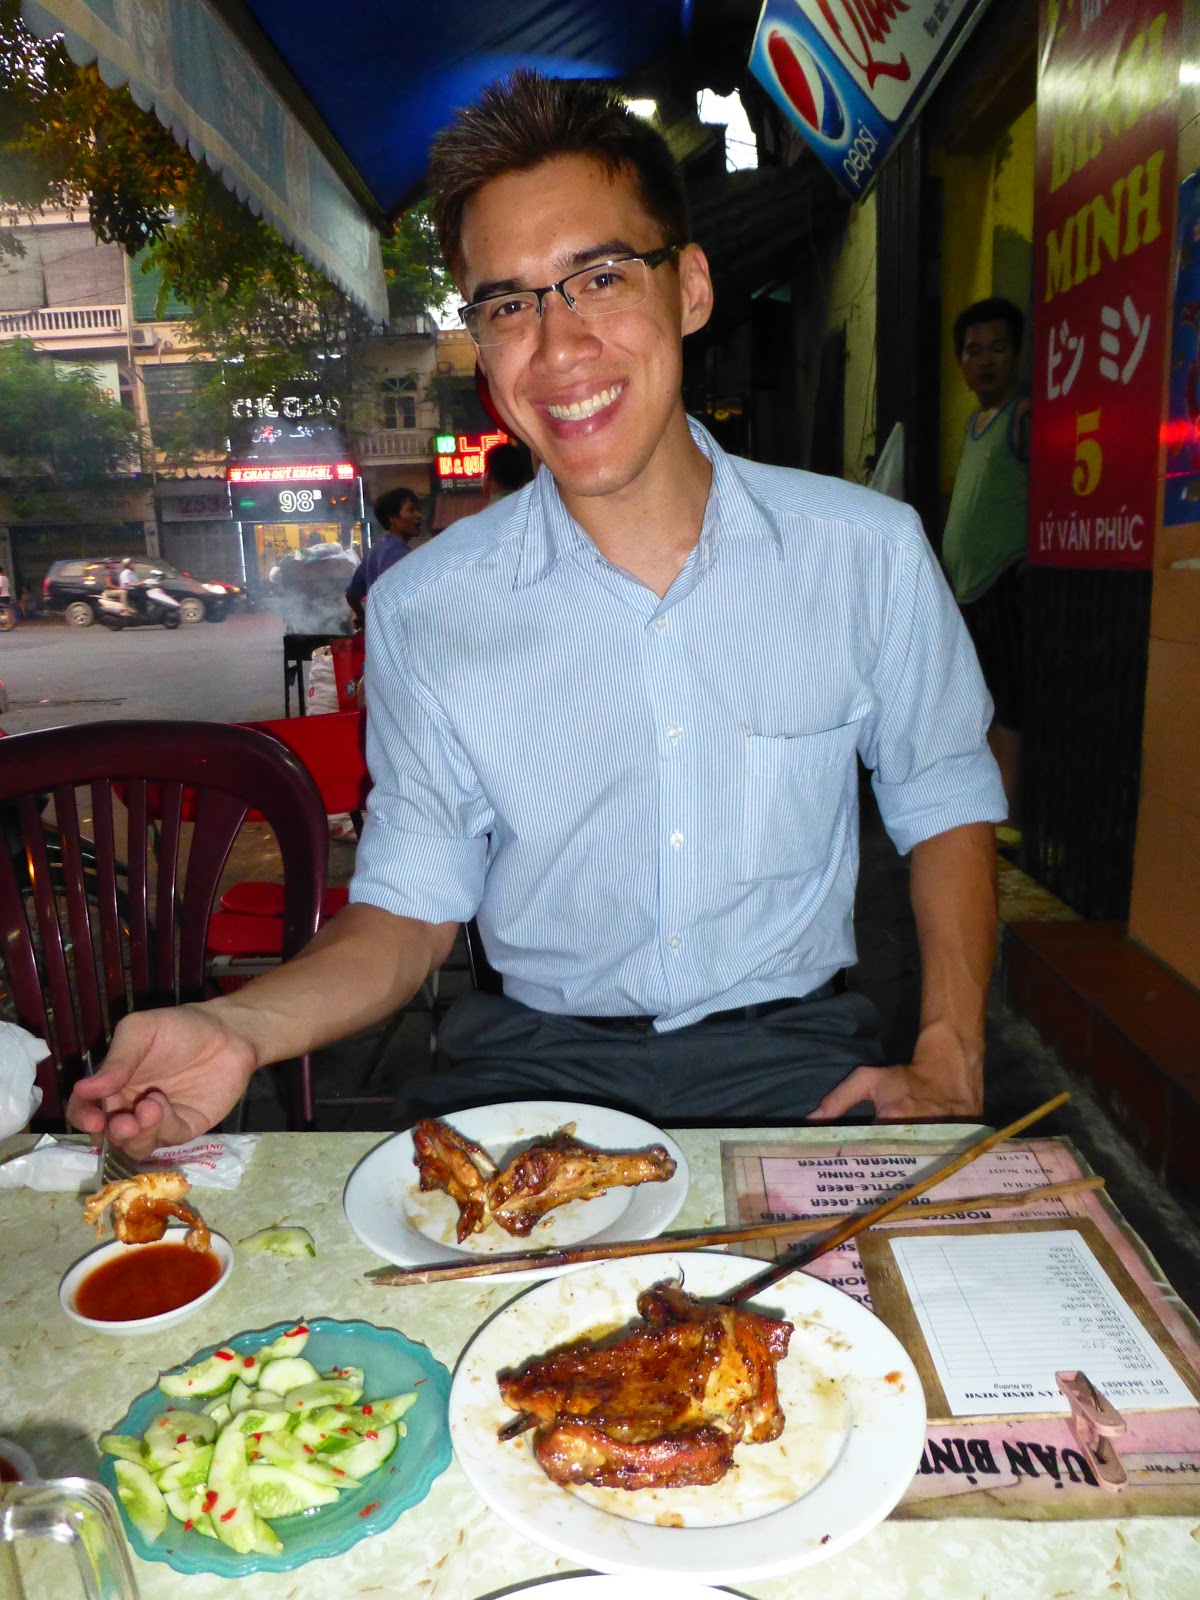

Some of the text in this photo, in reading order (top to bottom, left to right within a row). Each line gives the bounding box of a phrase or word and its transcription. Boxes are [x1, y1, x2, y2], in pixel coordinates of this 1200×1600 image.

[843, 118, 879, 188] pepsi
[1044, 150, 1166, 303] MINH
[1072, 407, 1103, 496] 5
[1040, 504, 1145, 551] LÝ VĂN PHÚC
[797, 1157, 917, 1167] MINERAL WATER
[817, 1170, 907, 1179] SOFT DRINK
[916, 1438, 1100, 1489] UÁN BÌN
